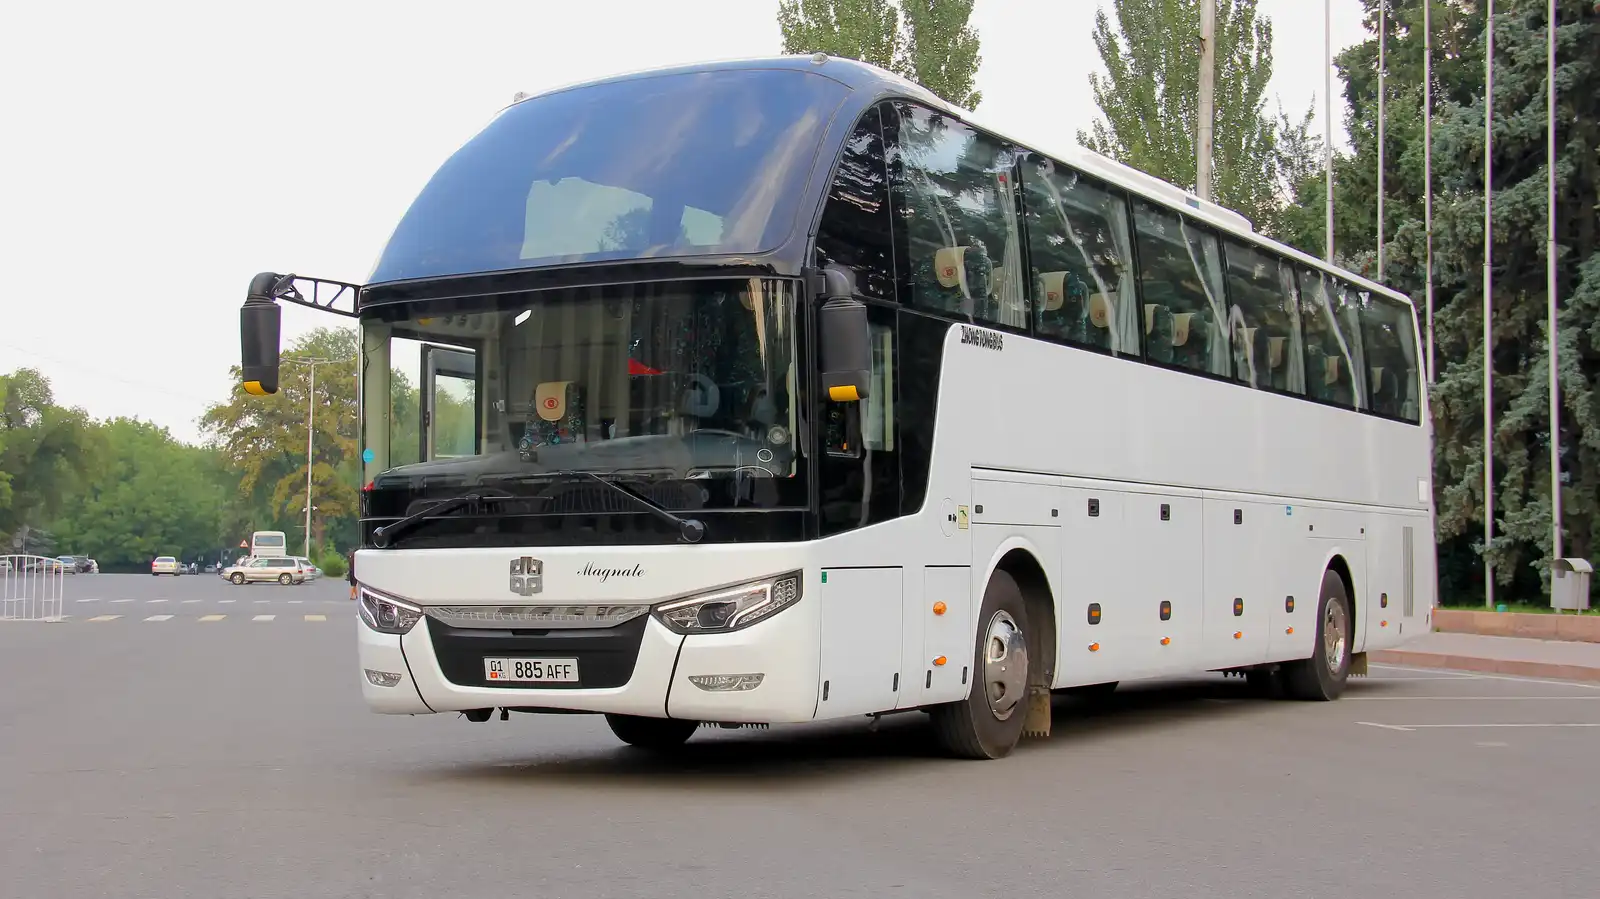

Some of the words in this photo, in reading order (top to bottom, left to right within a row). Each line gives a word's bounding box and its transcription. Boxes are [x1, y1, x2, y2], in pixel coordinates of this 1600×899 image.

[576, 561, 646, 583] Magnate
[490, 660, 503, 672] 01
[515, 661, 543, 679] 885
[546, 664, 571, 679] AFF
